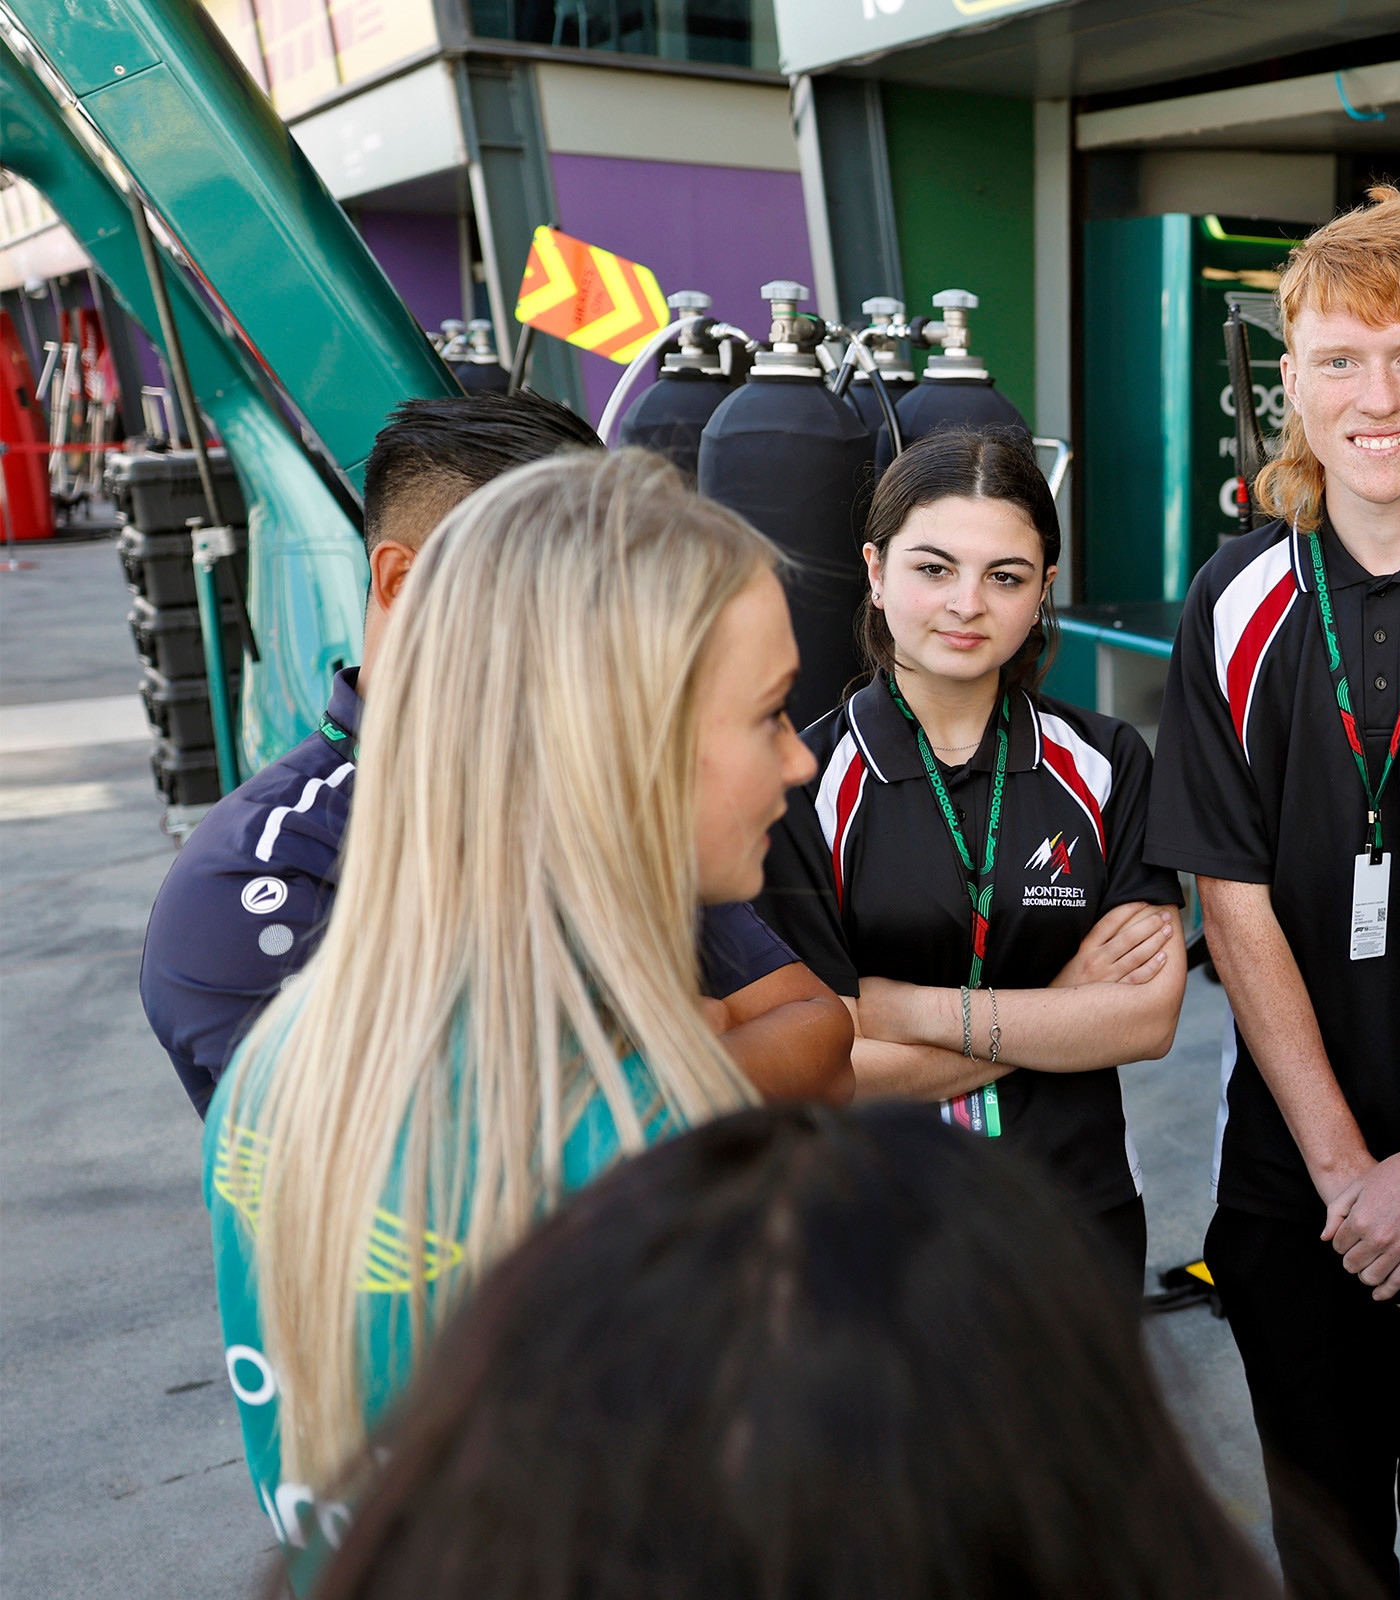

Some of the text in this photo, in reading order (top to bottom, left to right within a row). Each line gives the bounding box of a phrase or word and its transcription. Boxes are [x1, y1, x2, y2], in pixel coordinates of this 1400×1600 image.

[1310, 539, 1323, 568] 2023
[1314, 567, 1333, 630] PADDOCK
[918, 740, 936, 773] 2023
[996, 741, 1009, 772] 2023
[928, 769, 959, 830] PADDOCK
[989, 771, 1005, 830] PADDOCK
[1021, 898, 1087, 907] SECONDARY COLLEGE
[1023, 885, 1085, 898] MONTEREY
